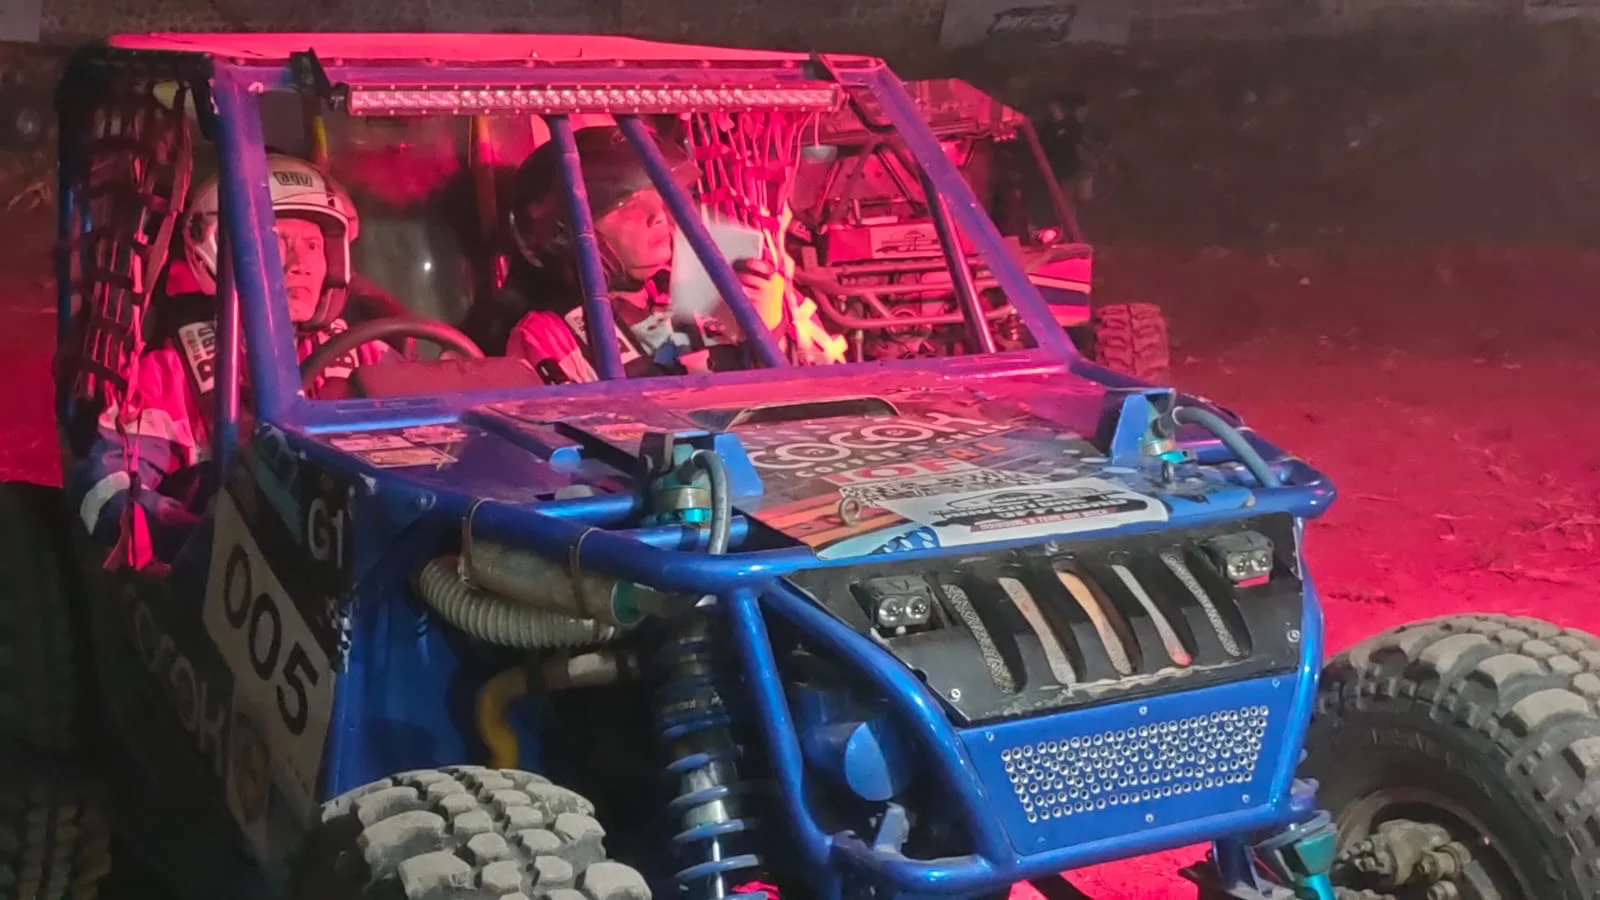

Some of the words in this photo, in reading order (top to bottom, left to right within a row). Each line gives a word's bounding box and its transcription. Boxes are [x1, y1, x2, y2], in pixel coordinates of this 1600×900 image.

[796, 448, 901, 477] COFFEE
[935, 423, 1011, 444] CHILL
[224, 543, 319, 736] 005
